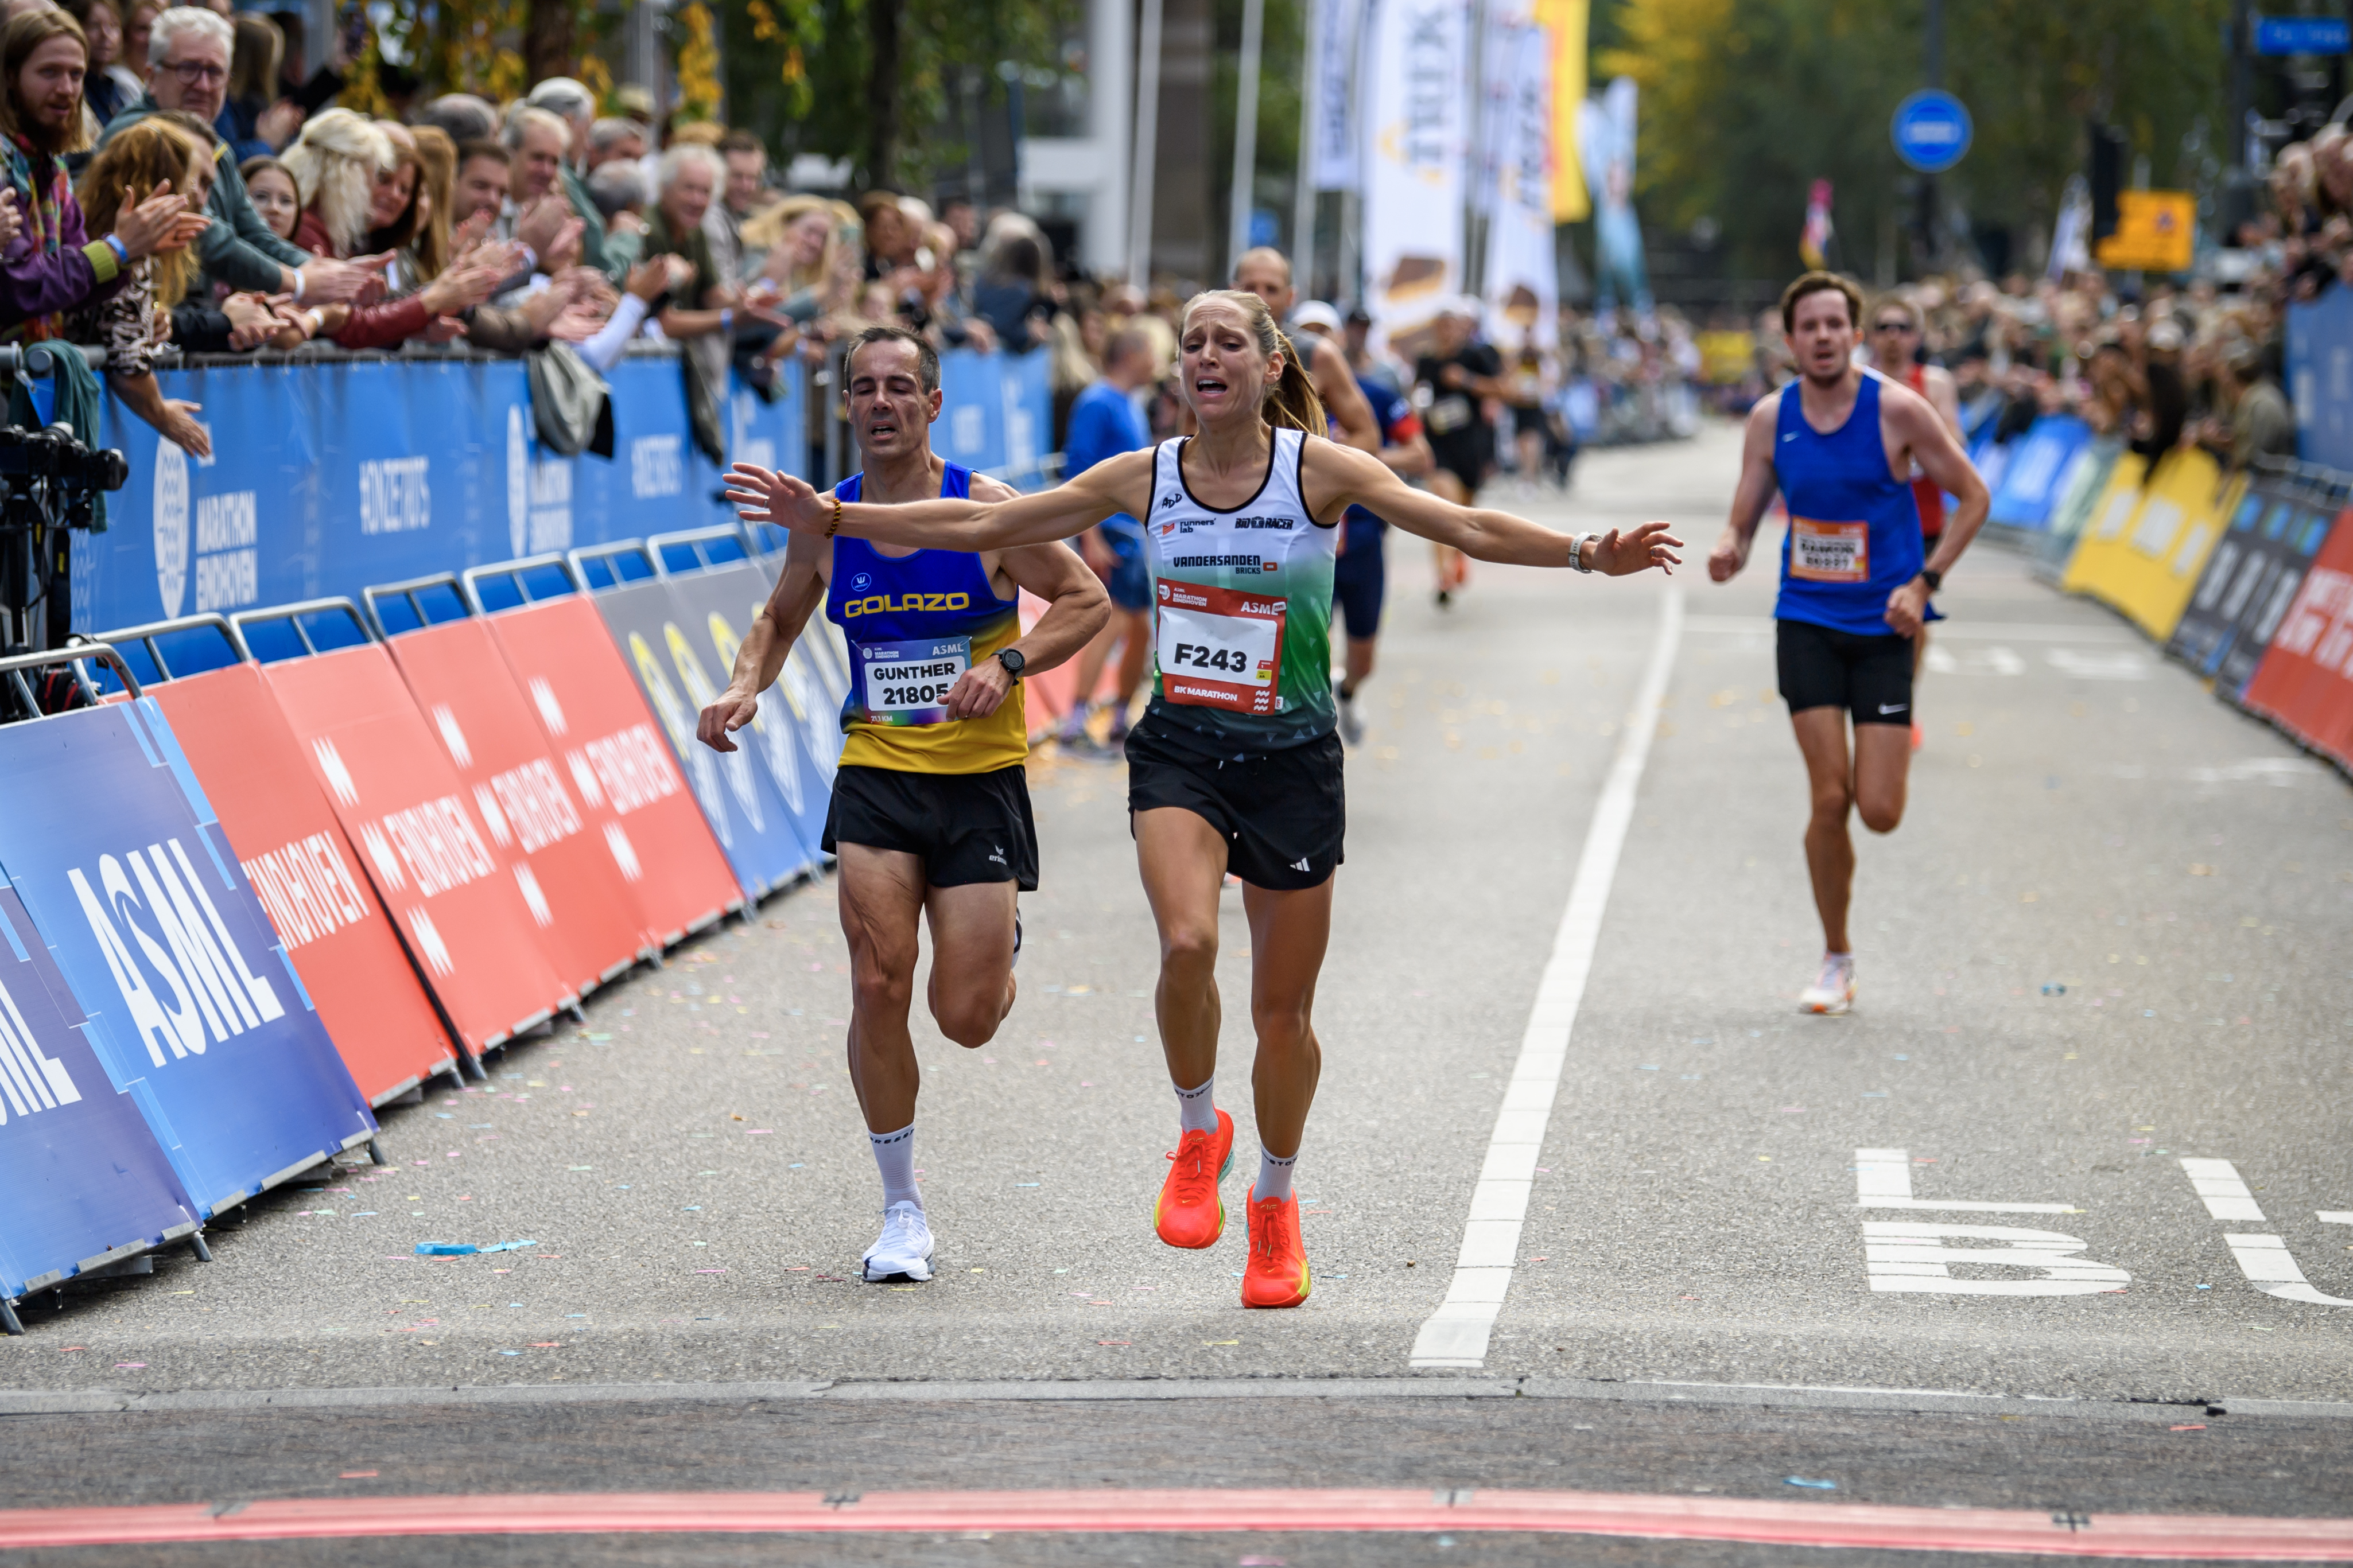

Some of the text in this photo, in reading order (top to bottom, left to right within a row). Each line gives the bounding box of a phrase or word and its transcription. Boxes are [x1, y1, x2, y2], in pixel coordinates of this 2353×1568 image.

[1173, 555, 1261, 567] VANDERSANDEN
[845, 593, 969, 618] GOLAZO
[1173, 598, 1206, 606] EINDHOVEN
[1174, 593, 1207, 602] MARATHON
[1241, 601, 1279, 616] ASML
[933, 644, 964, 656] ASML
[1174, 643, 1247, 673] F243
[873, 662, 956, 680] GUNTHER
[883, 683, 949, 705] 21805
[1174, 686, 1237, 701] BK MARATHON
[383, 794, 497, 898] EINDHOVEN
[67, 838, 285, 1067] ASML
